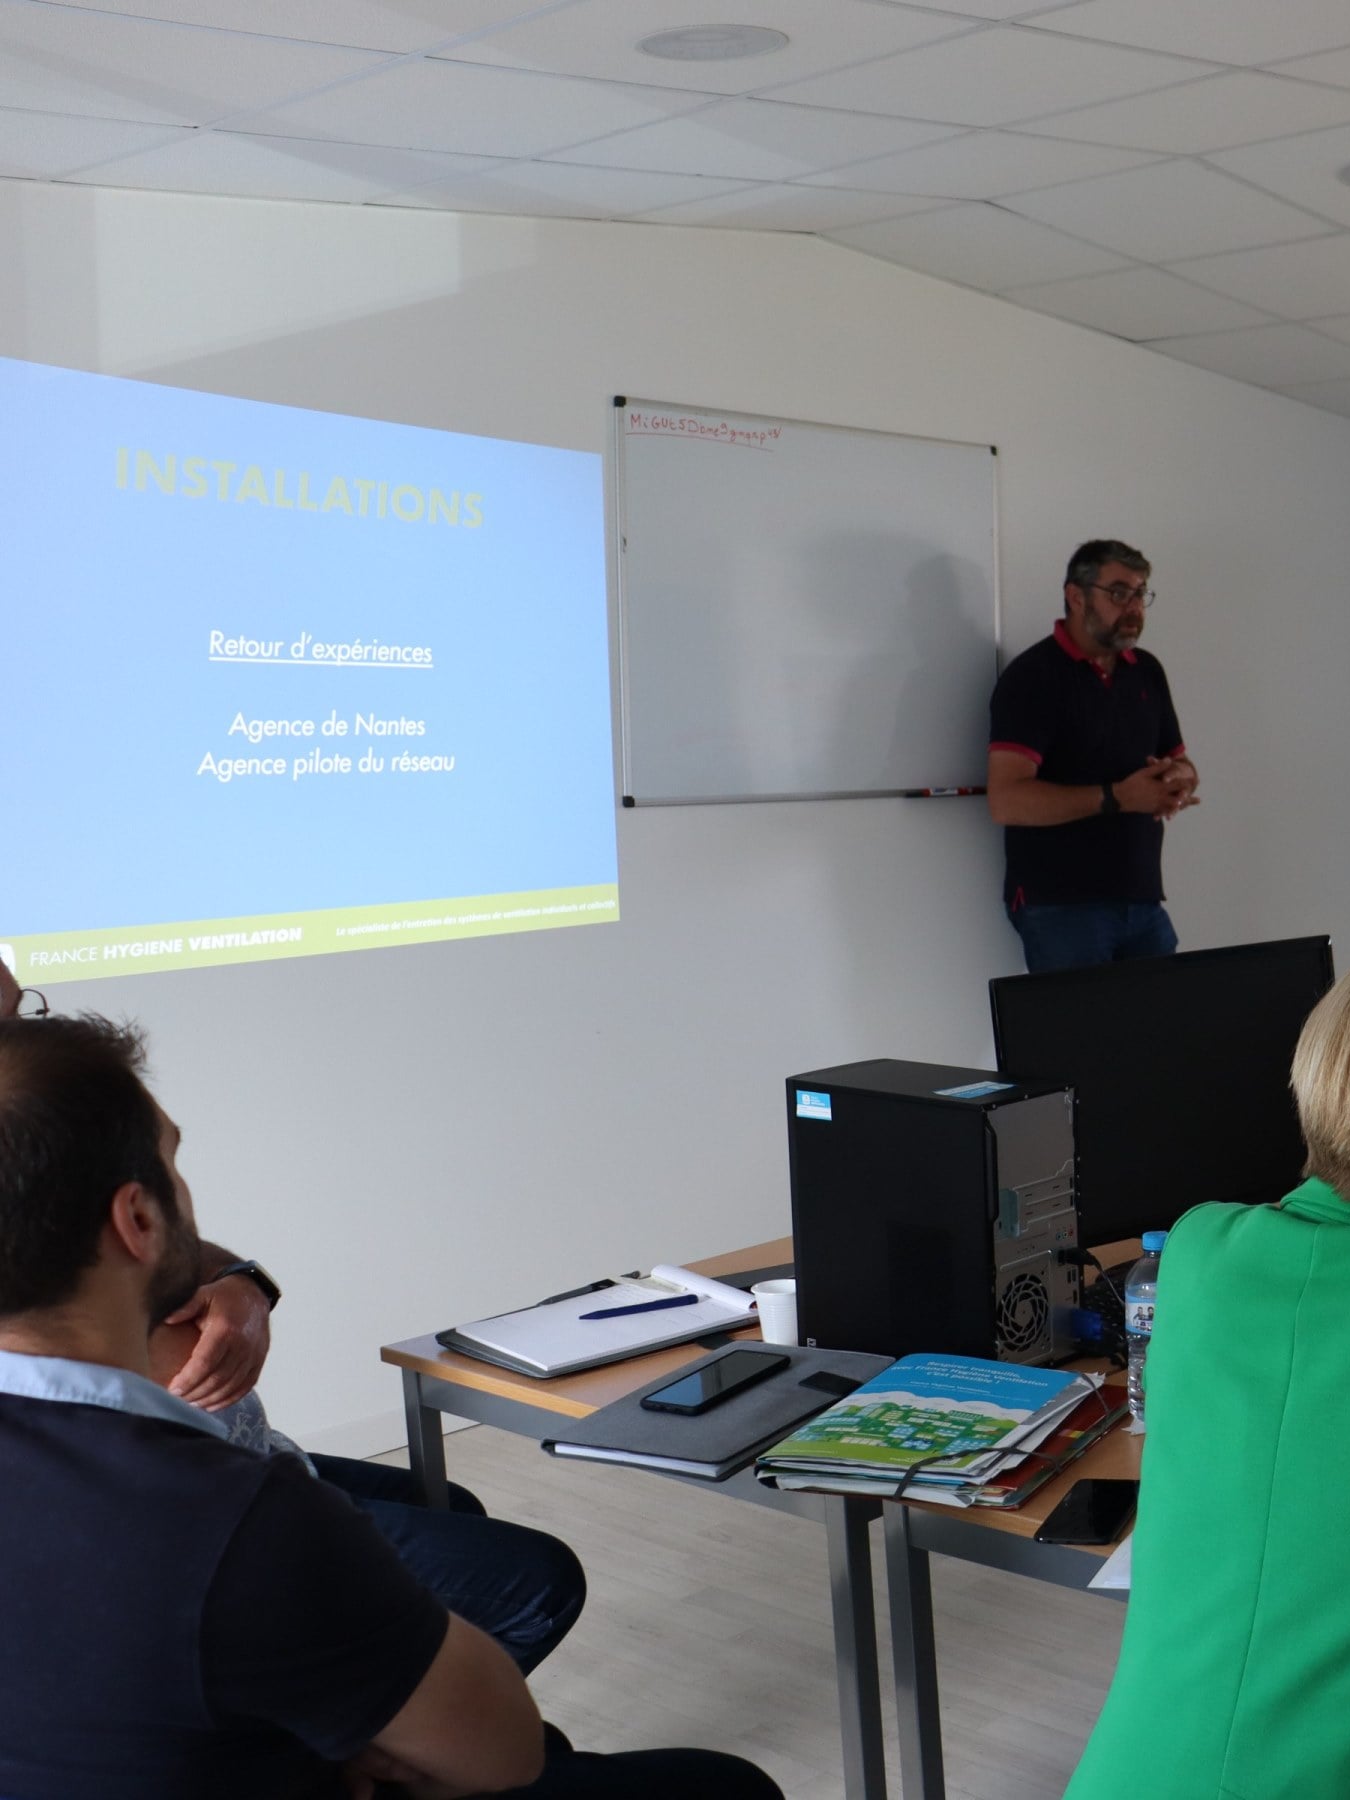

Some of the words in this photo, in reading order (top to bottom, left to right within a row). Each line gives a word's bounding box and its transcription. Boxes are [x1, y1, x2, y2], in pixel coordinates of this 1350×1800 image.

[115, 446, 484, 529] INSTALLATIONS
[209, 629, 284, 657] Retour
[290, 631, 433, 666] d'expériences
[228, 711, 316, 743] Agence
[321, 709, 349, 736] de
[354, 712, 426, 737] Nantes
[197, 750, 287, 783] Agence
[292, 747, 352, 781] pilote
[358, 746, 385, 773] du
[391, 750, 456, 773] réseau
[30, 946, 98, 967] FRANCE
[103, 939, 184, 960] HYGIENE
[188, 927, 304, 952] VENTILATION
